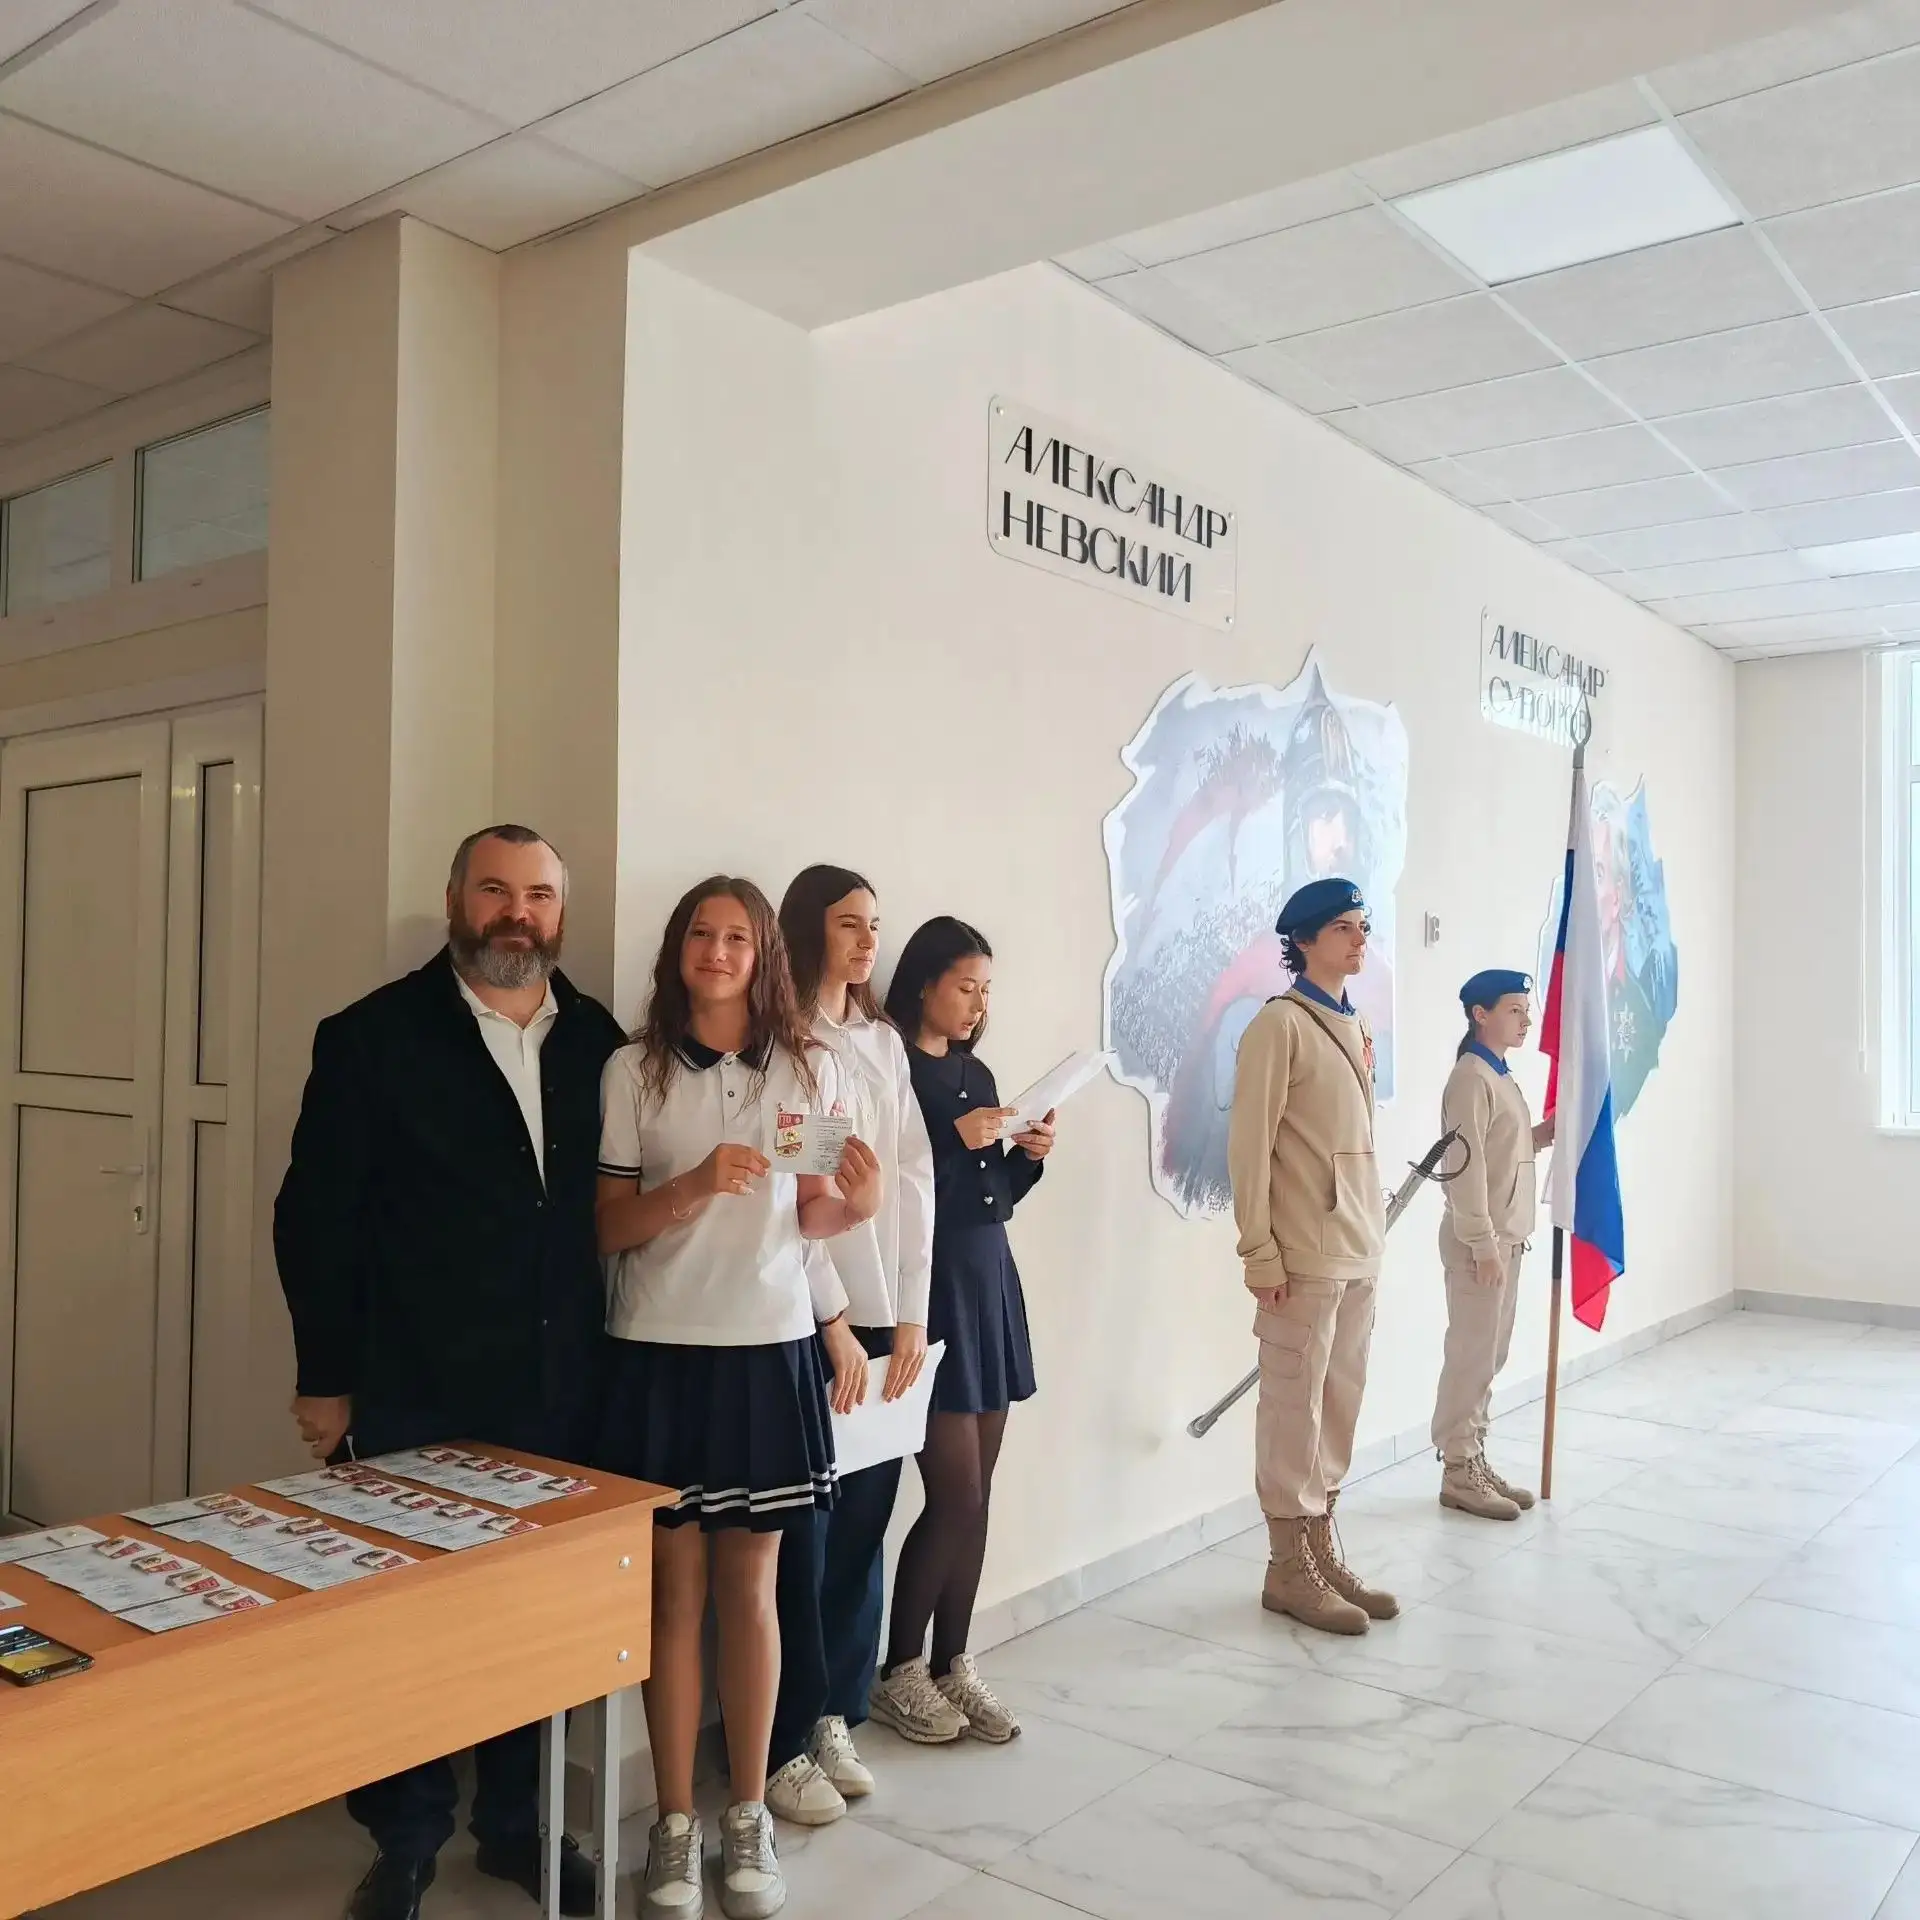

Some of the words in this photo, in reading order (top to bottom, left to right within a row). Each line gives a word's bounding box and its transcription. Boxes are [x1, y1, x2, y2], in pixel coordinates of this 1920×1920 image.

[1005, 426, 1227, 549] АЛЕКСАНДР
[1003, 491, 1191, 603] НЕВСКИЙ
[1489, 624, 1605, 698] АЛЕКСАНДР
